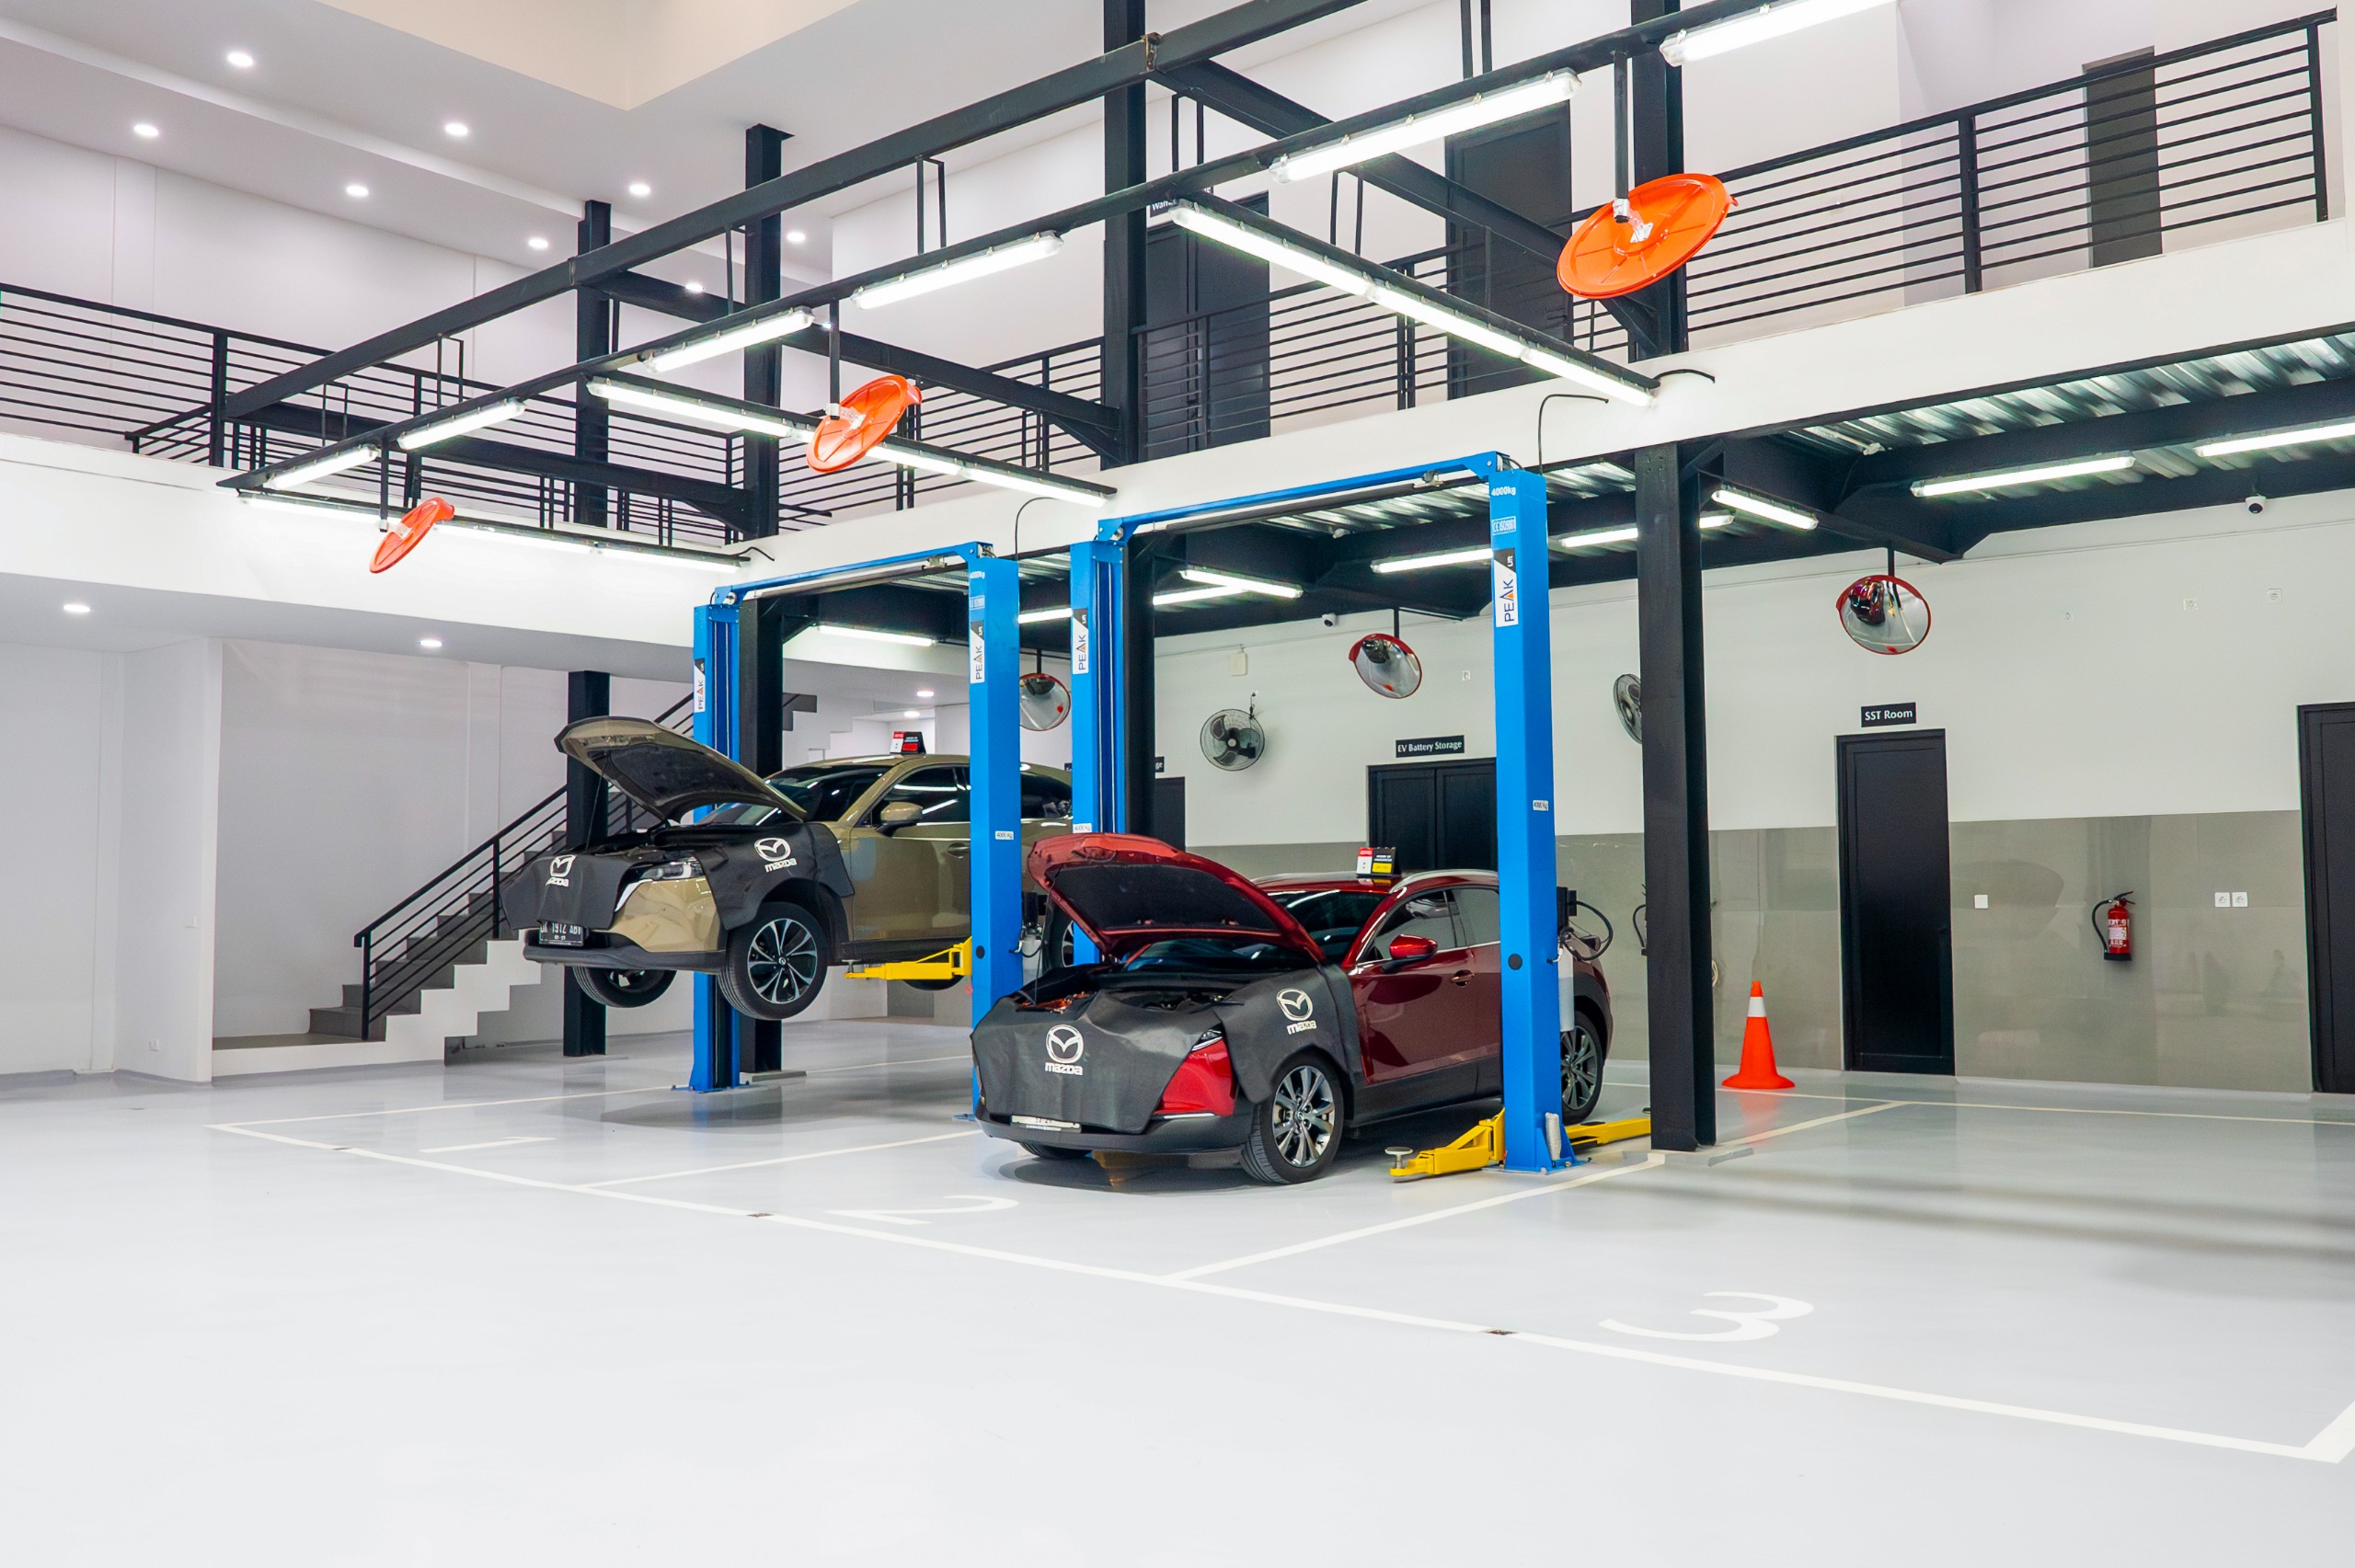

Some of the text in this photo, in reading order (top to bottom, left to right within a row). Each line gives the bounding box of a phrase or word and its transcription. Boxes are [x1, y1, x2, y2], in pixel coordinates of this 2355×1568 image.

[1499, 578, 1515, 623] PEAK
[973, 646, 982, 681] PEAK
[1076, 634, 1086, 670] PEAK
[1865, 710, 1913, 721] SST Room
[1397, 740, 1463, 753] EV Battery Storage
[1045, 1061, 1084, 1076] mazda
[824, 1195, 1019, 1225] 2
[1597, 1290, 1814, 1342] 3
